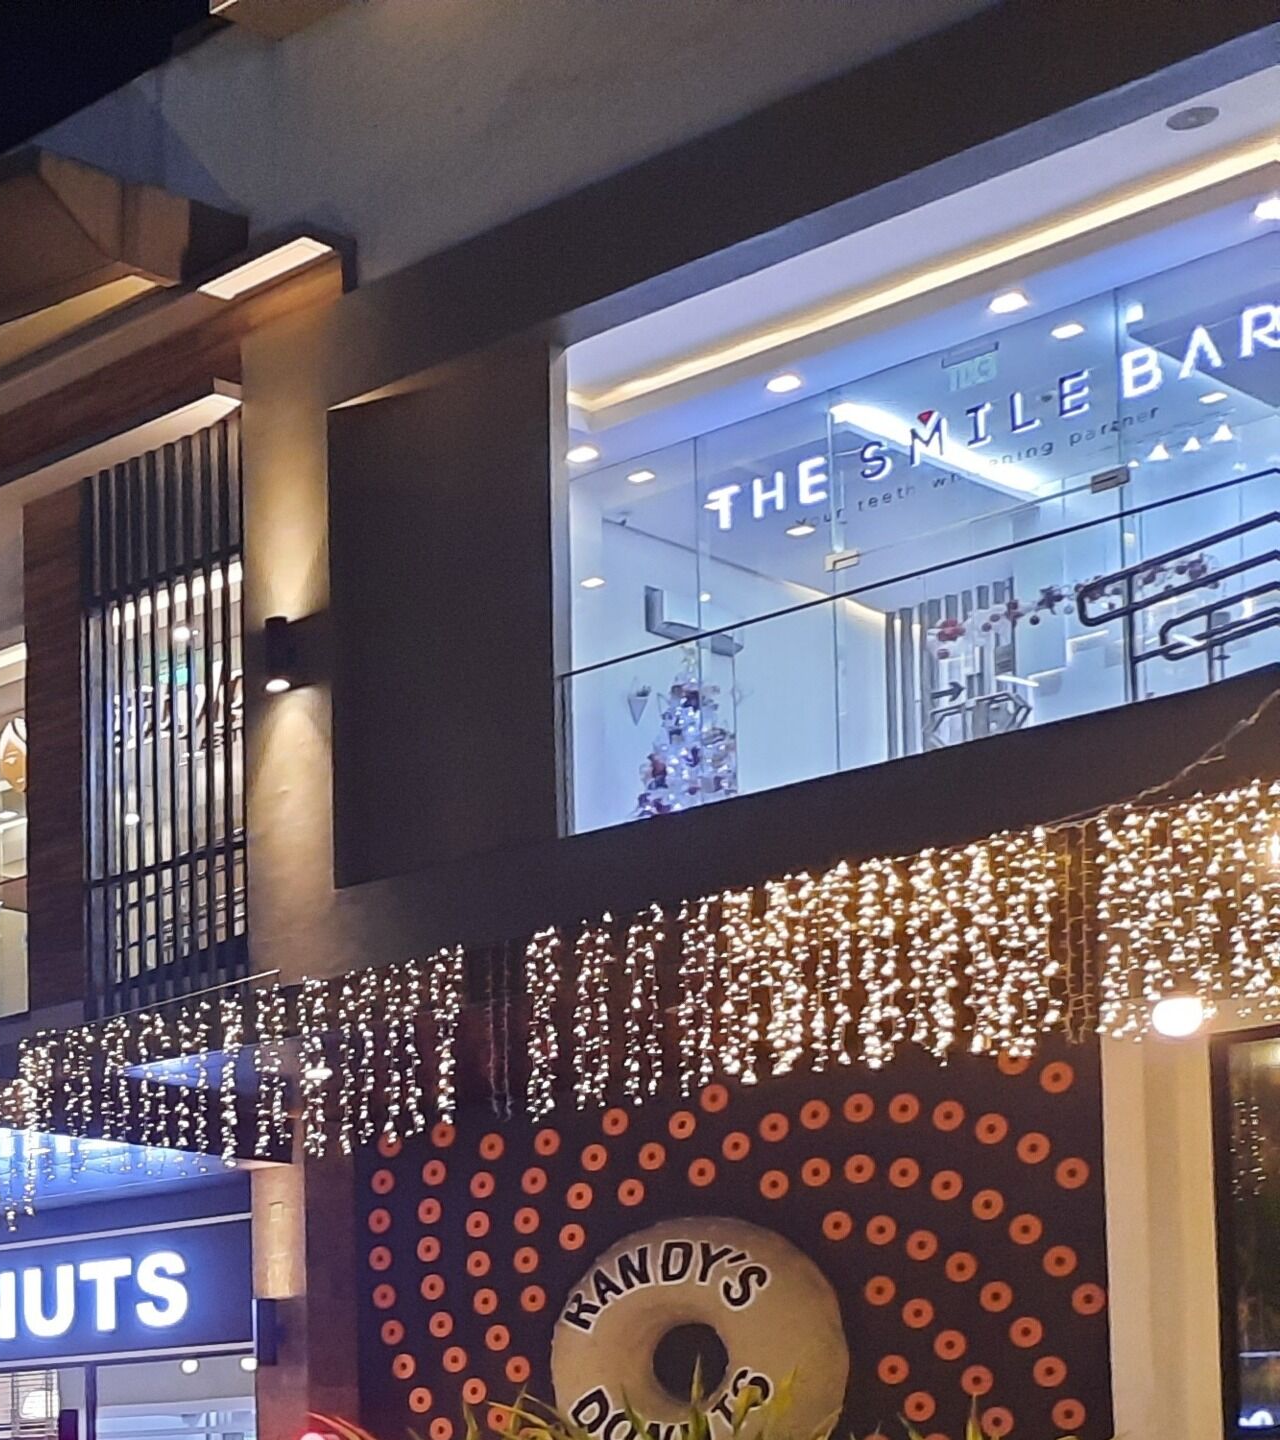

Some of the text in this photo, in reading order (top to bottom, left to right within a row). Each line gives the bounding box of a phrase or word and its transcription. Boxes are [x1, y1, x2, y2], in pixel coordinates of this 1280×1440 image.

[710, 455, 828, 531] THE
[859, 369, 1091, 481] SMILE
[1068, 405, 1160, 445] partner
[562, 1240, 772, 1334] RANDY'S
